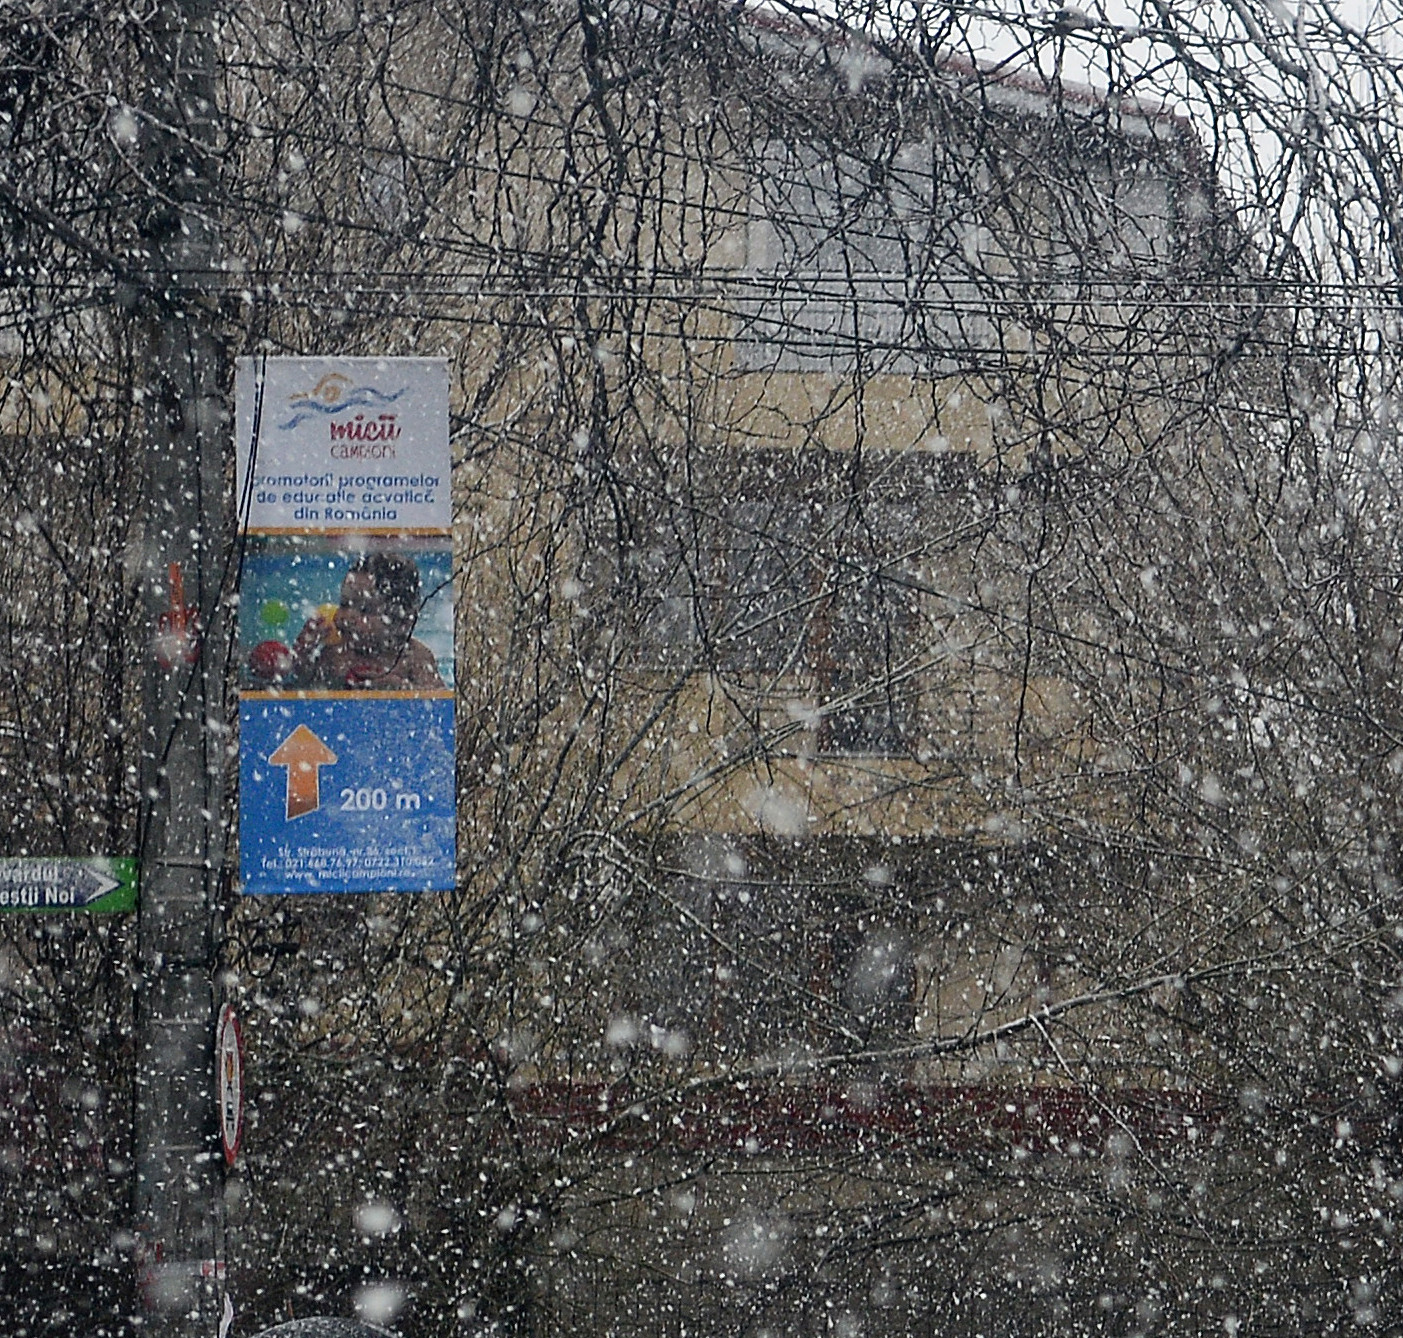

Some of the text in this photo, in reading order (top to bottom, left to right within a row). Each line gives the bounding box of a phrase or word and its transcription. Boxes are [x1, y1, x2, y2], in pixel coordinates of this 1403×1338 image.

[330, 414, 402, 441] micii
[330, 444, 396, 462] campioni
[339, 473, 440, 490] programelor
[256, 491, 277, 503] de
[294, 505, 398, 520] din România
[340, 788, 421, 811] 200 m
[0, 863, 58, 883] vardul
[45, 886, 75, 904] Noi
